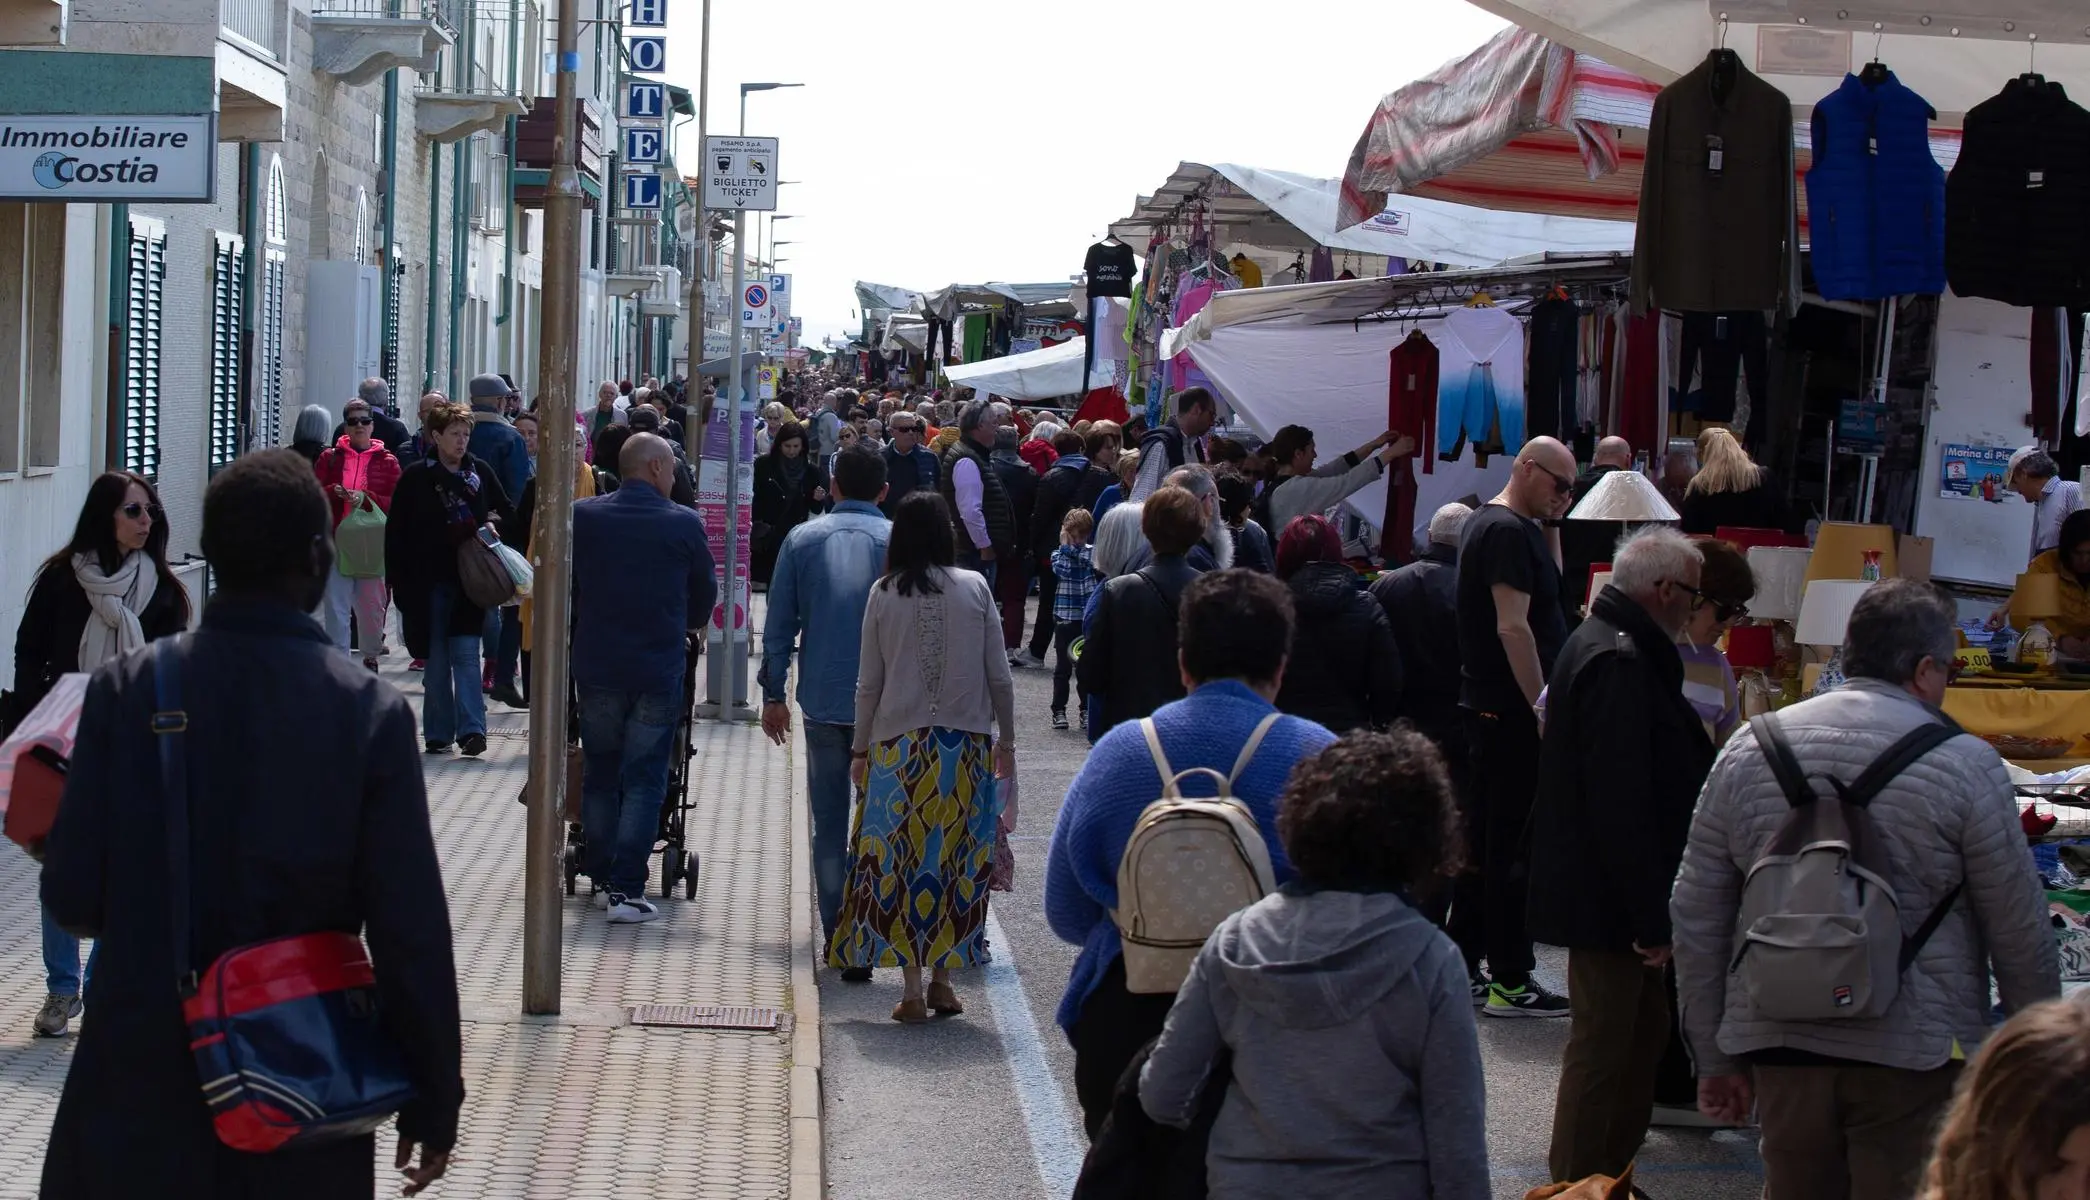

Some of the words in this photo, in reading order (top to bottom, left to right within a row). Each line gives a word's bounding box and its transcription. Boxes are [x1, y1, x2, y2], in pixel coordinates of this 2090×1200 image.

[630, 0, 665, 207] HOTEL
[1, 126, 189, 148] Immobiliare
[54, 156, 159, 183] Costia
[713, 177, 767, 188] BIGLIETTO
[721, 187, 759, 197] TICKET
[772, 276, 782, 290] P
[1948, 448, 1982, 459] Marina
[1984, 449, 1993, 459] di
[1996, 450, 2011, 461] Pis
